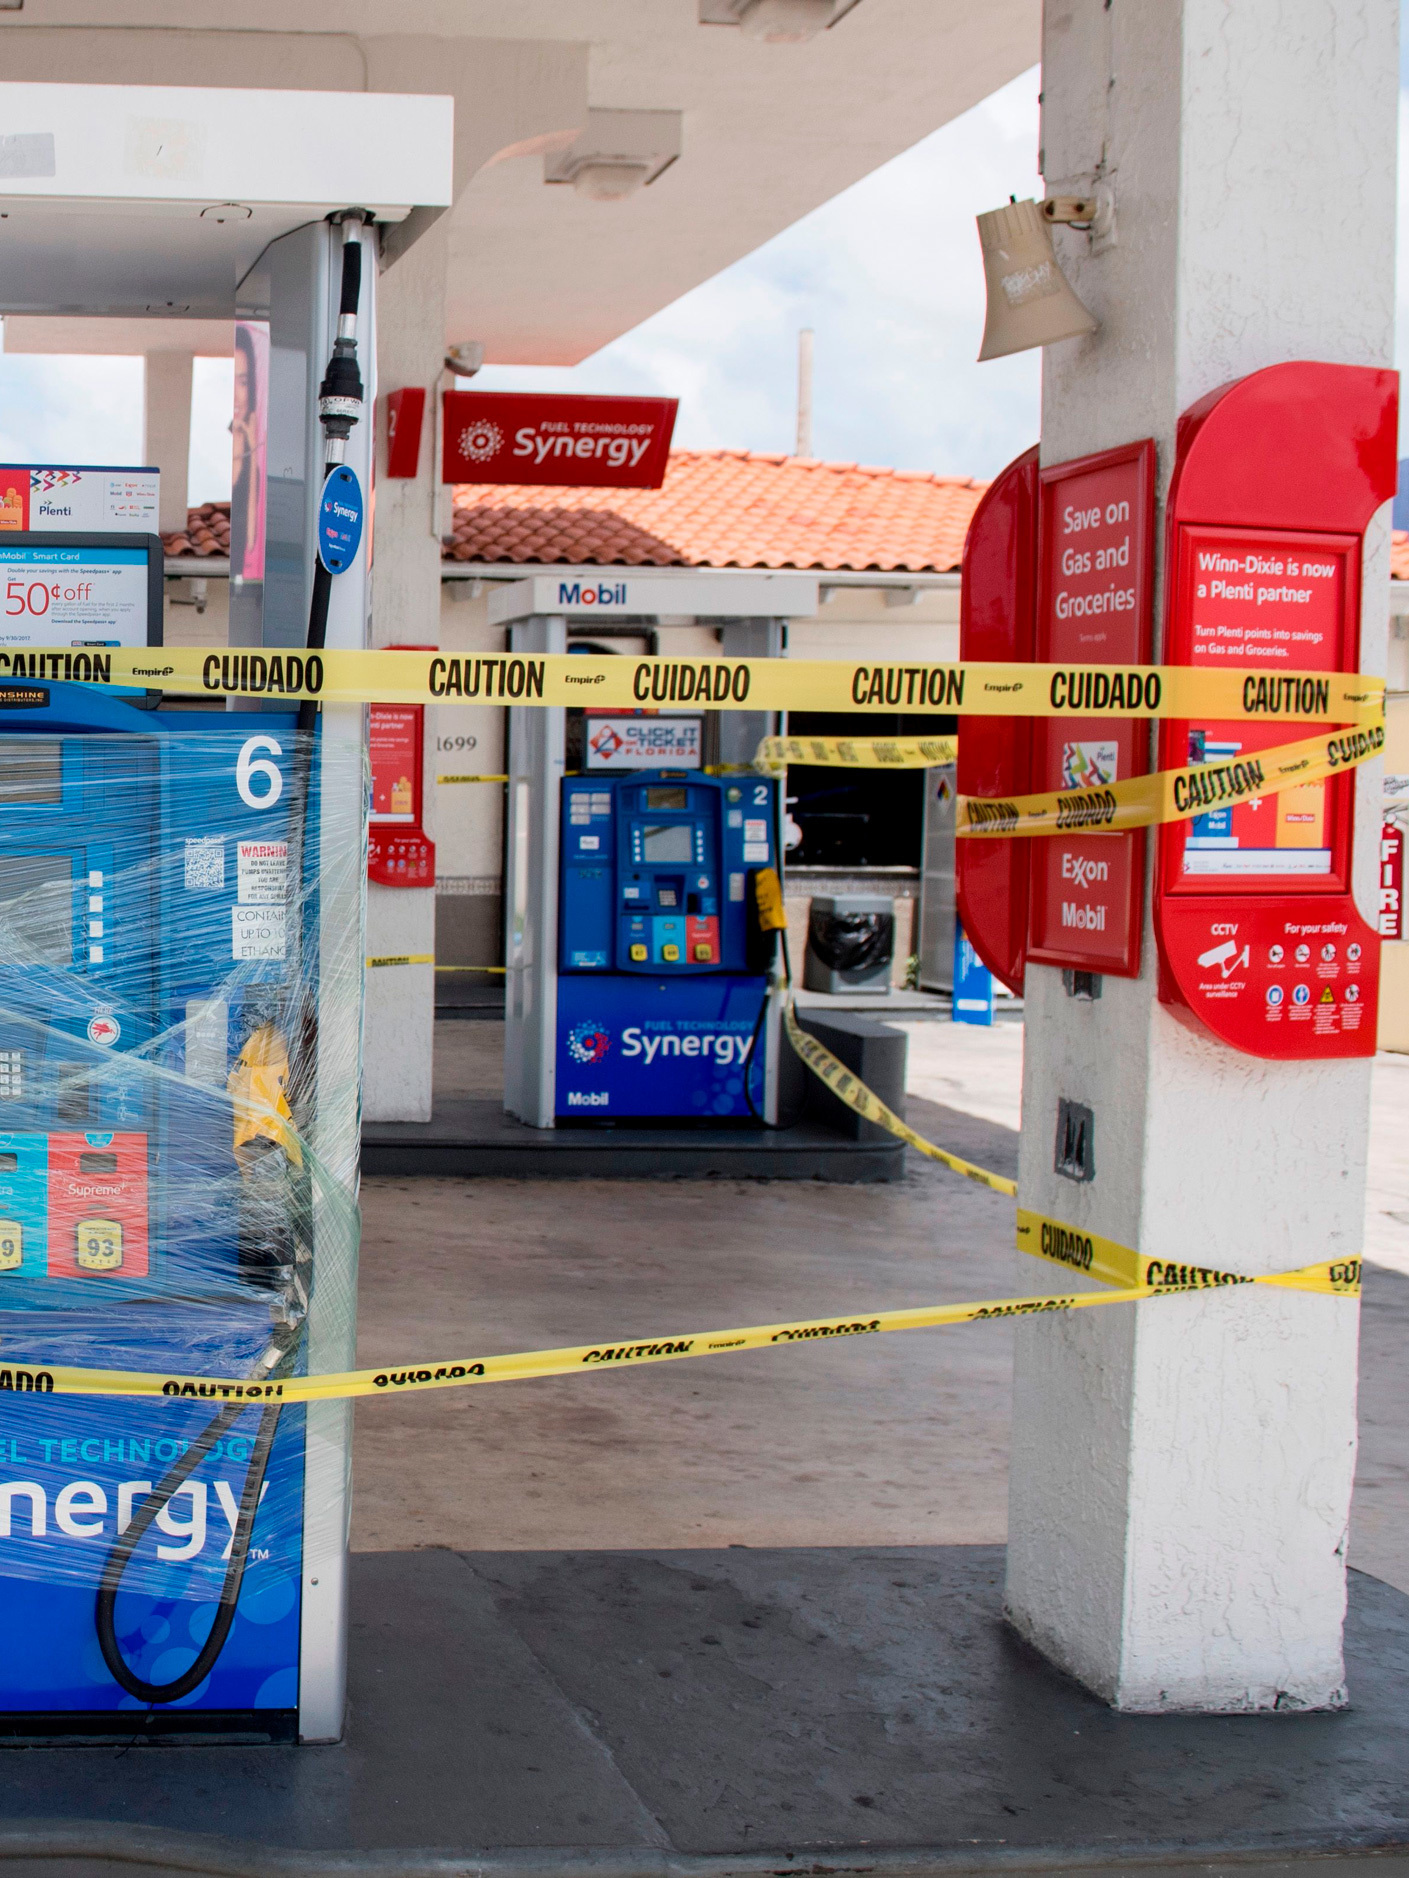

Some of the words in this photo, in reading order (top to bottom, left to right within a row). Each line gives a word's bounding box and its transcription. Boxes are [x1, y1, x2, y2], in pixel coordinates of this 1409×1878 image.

[541, 421, 569, 433] FUEL
[574, 422, 654, 435] TECHNOLOGY
[513, 428, 651, 467] Synergy
[39, 506, 72, 516] Plenti
[334, 502, 358, 522] Synergy
[1063, 505, 1101, 534] Save
[1106, 500, 1129, 524] on
[32, 552, 58, 560] Smart
[60, 552, 80, 560] Card
[1062, 548, 1091, 576] Gas
[1096, 536, 1129, 570] and
[1198, 553, 1283, 575] Winn-Dixie
[1287, 558, 1299, 577] is
[1302, 562, 1335, 578] now
[64, 583, 93, 600] off
[559, 583, 626, 605] Mobil
[1055, 583, 1135, 620] Groceries
[1197, 584, 1206, 598] a
[1210, 580, 1253, 600] Plenti
[1257, 585, 1312, 605] partner
[1194, 625, 1215, 636] Turn
[1217, 626, 1242, 638] Plenti
[1244, 628, 1271, 643] points
[1273, 629, 1290, 640] into
[1292, 631, 1323, 644] savings
[1194, 644, 1206, 653] on
[1208, 643, 1225, 654] Gas
[1227, 643, 1244, 655] and
[132, 666, 174, 677] Empire
[202, 654, 323, 695] CUIDADO
[428, 657, 545, 698] CAUTION
[565, 674, 606, 685] Empire
[633, 663, 750, 702] CUIDADO
[852, 667, 965, 706] CAUTION
[1050, 671, 1162, 710] CUIDADO
[1243, 675, 1329, 714] CAUTION
[626, 727, 675, 737] CLICK
[683, 727, 697, 736] IT
[638, 737, 697, 747] TICKET
[625, 747, 697, 756] FLORIDA
[1327, 726, 1385, 767] CUIDAD
[236, 735, 283, 810] 6
[754, 786, 768, 805] 2
[1173, 759, 1265, 812] CAUTION
[1055, 789, 1117, 829] CUIDADO
[240, 845, 288, 858] WARNIN
[1062, 853, 1108, 888] Exxon
[1378, 839, 1400, 936] FIRE
[1062, 902, 1106, 931] Mobil
[1210, 923, 1239, 936] CCTV
[1284, 923, 1299, 934] For
[1300, 925, 1321, 936] your
[1322, 922, 1348, 936] safety
[622, 1027, 754, 1065] Synergy
[567, 1091, 609, 1106] Mobil
[87, 1238, 114, 1257] 93
[1040, 1222, 1093, 1271] CUIDADO
[39, 1438, 257, 1463] TECHNOOG
